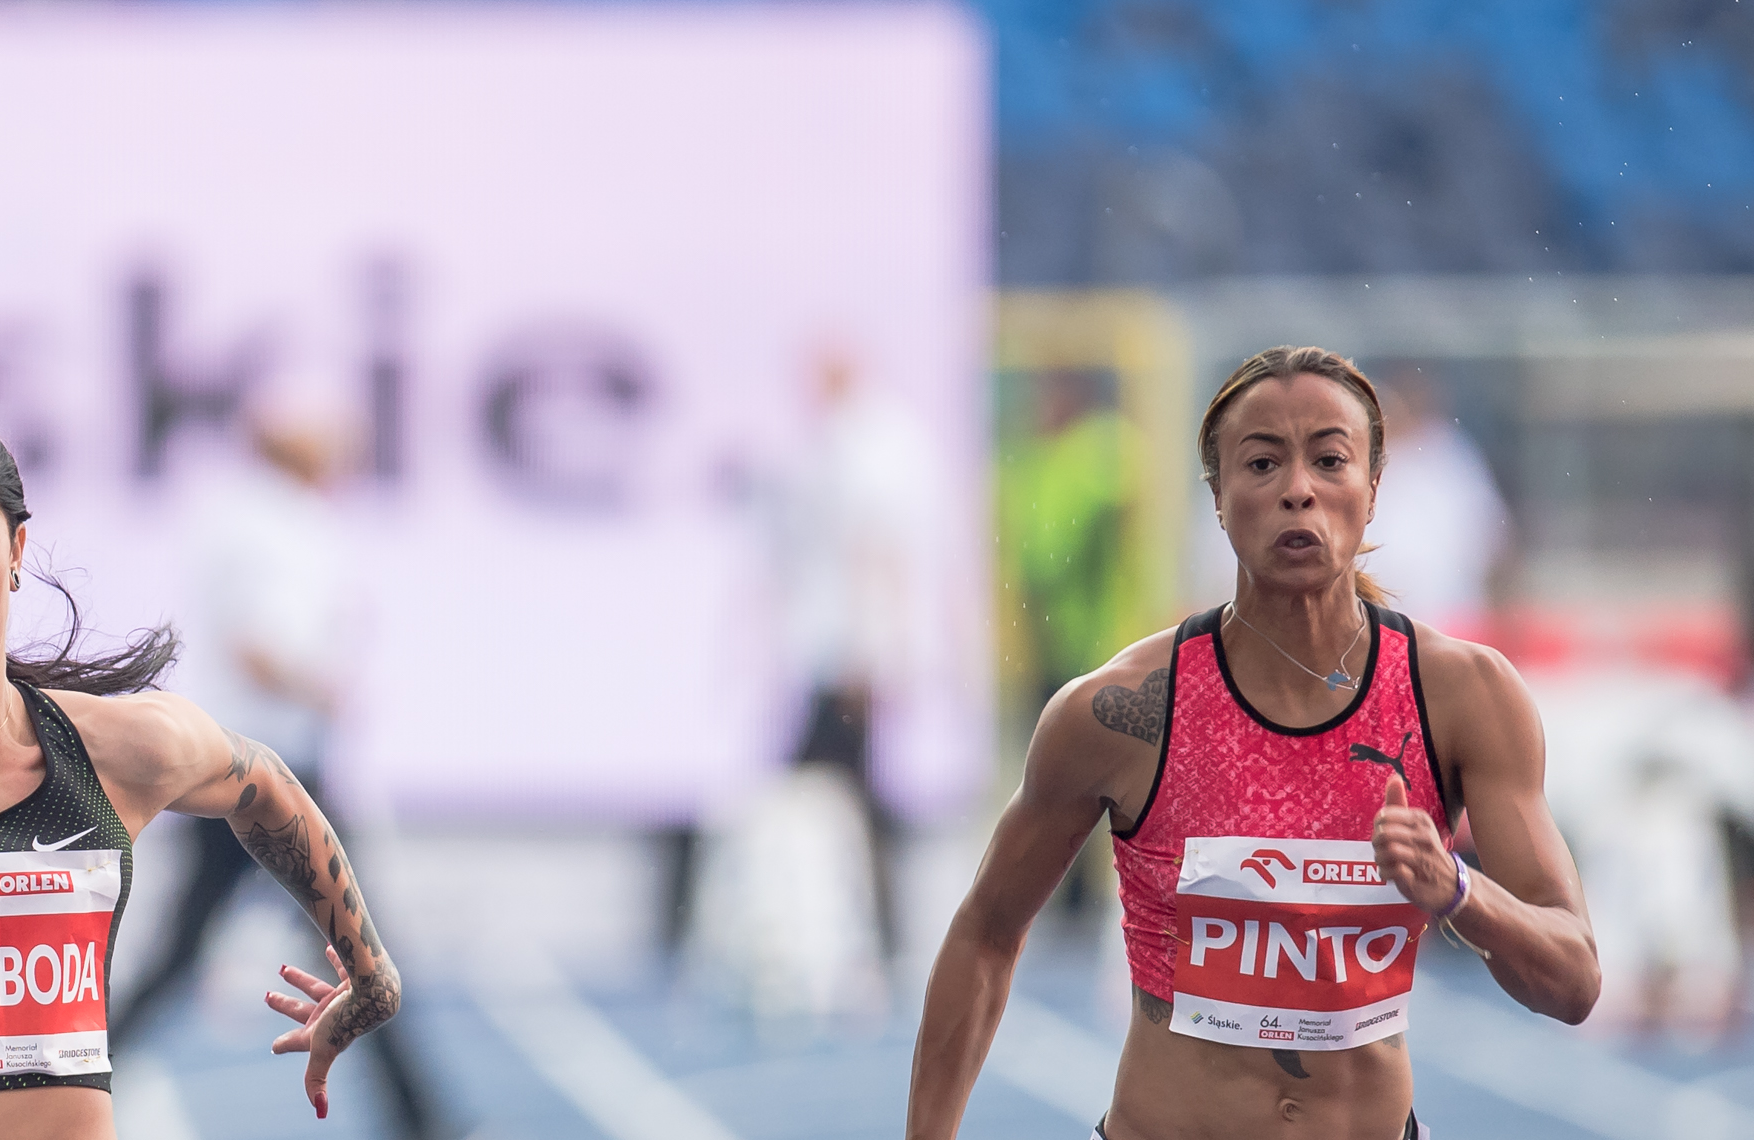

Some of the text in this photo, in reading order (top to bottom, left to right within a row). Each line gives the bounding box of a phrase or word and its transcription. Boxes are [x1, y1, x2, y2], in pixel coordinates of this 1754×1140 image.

[1307, 862, 1382, 883] ORLEN
[0, 873, 70, 893] ORLEN
[1189, 916, 1408, 984] PINTO
[1260, 1030, 1294, 1040] ORLEN
